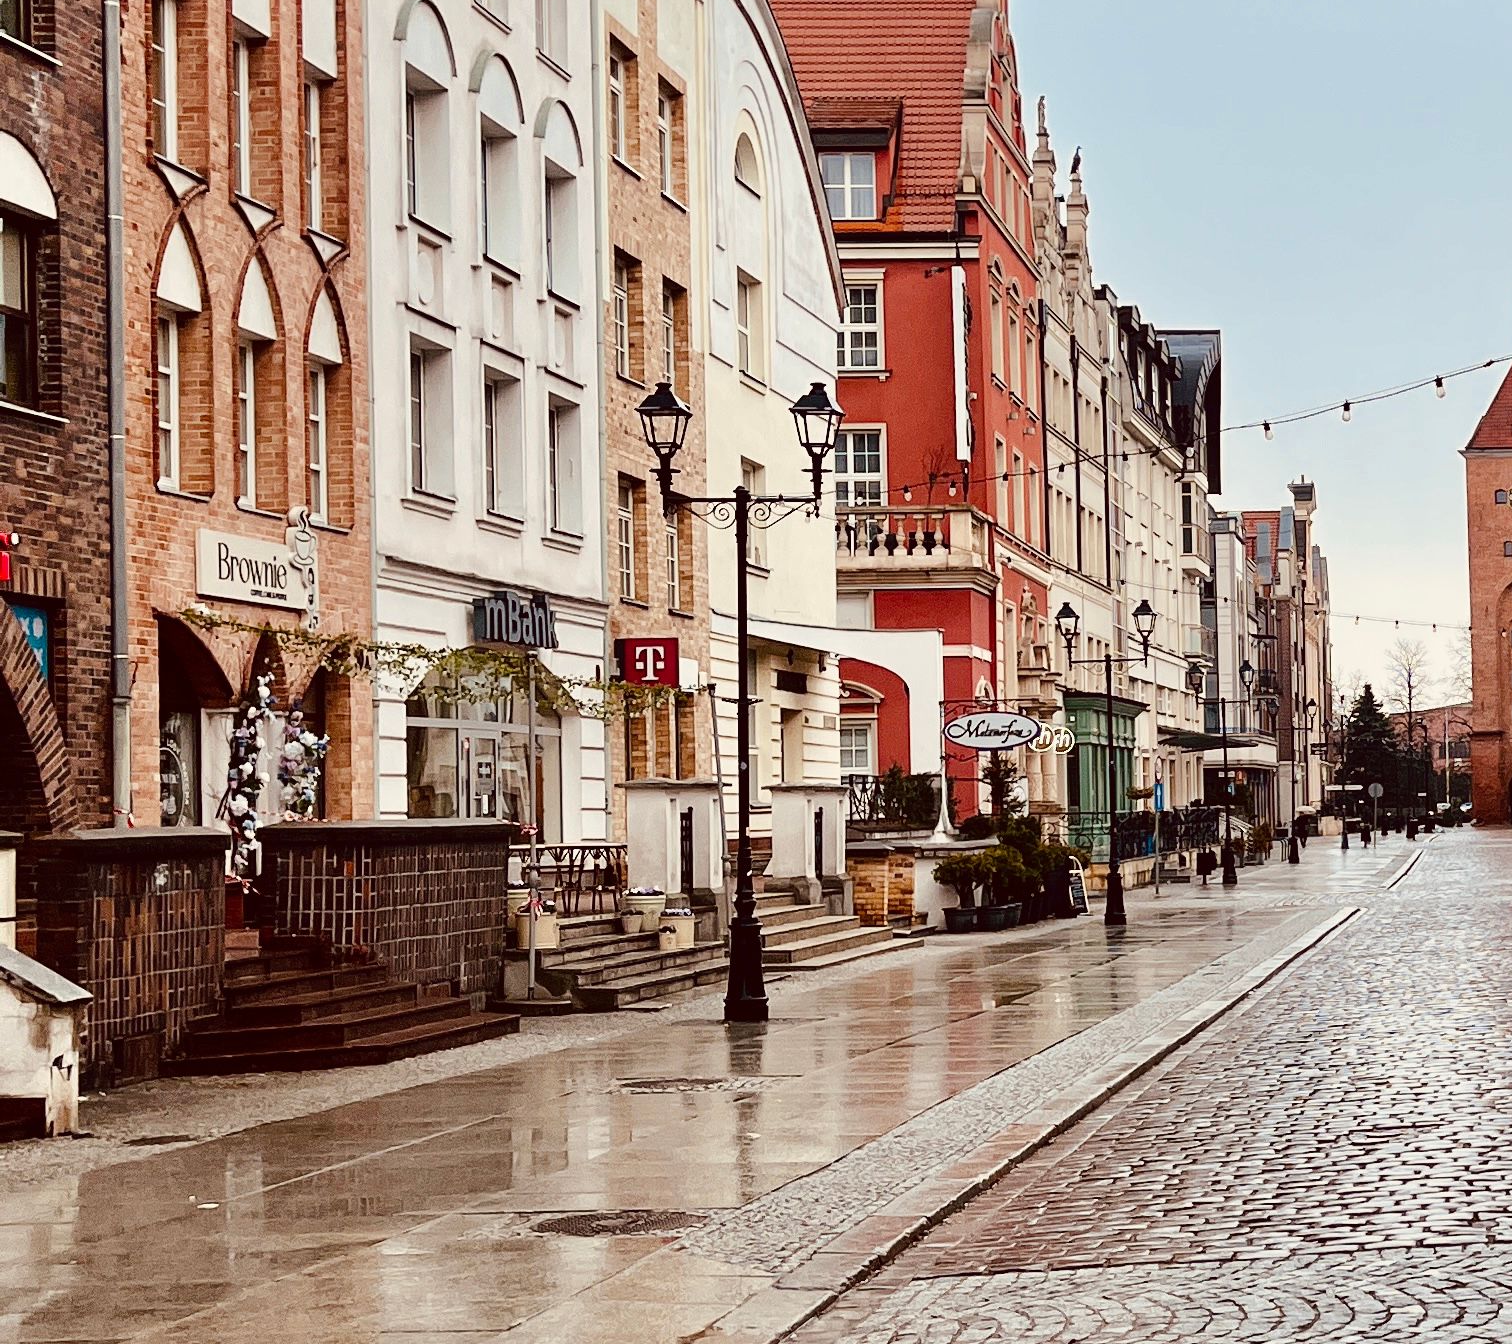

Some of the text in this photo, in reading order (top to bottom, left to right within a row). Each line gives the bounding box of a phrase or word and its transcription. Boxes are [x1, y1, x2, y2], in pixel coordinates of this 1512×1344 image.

[218, 542, 287, 590] Brownie
[484, 591, 559, 649] mBank
[635, 646, 665, 681] T
